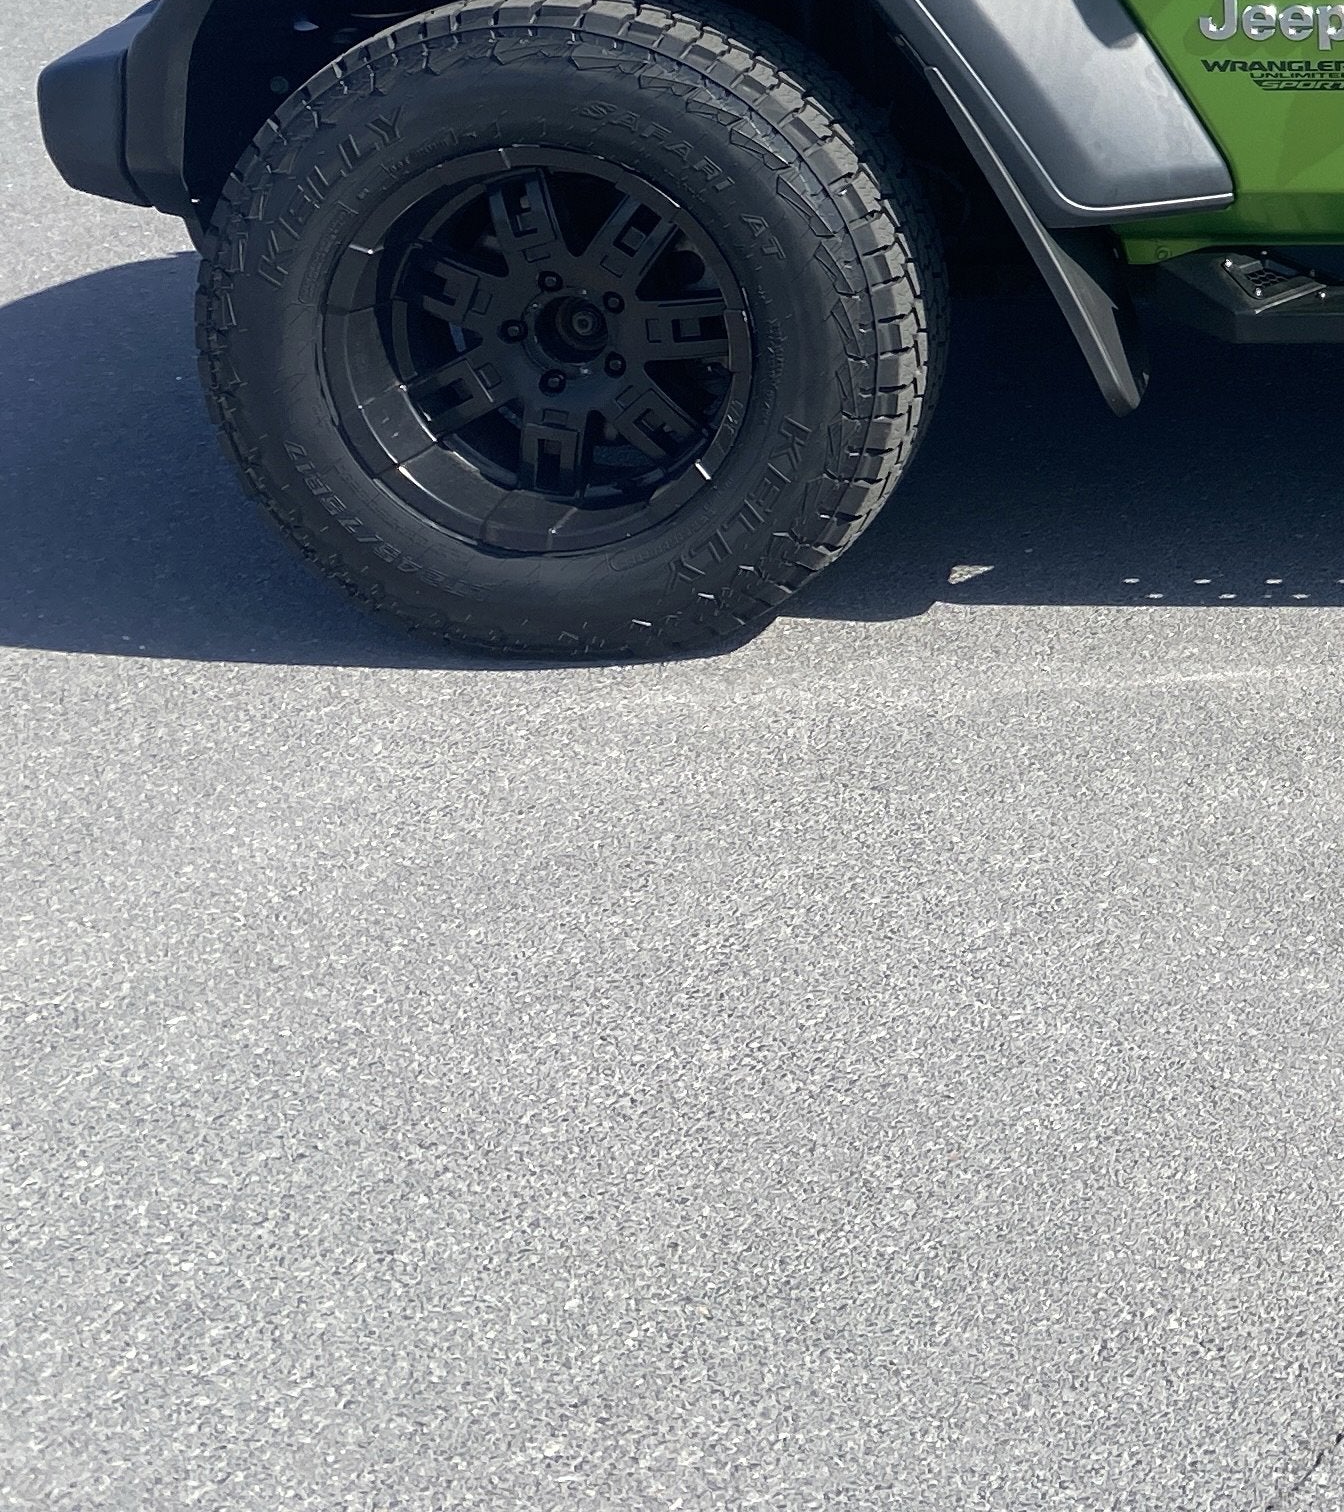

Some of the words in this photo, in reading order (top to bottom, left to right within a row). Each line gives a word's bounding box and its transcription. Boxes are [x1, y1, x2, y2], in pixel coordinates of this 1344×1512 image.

[257, 104, 404, 288] KELLY
[579, 99, 736, 193] SAFARI
[741, 212, 787, 259] AT
[664, 408, 813, 589] KELLY
